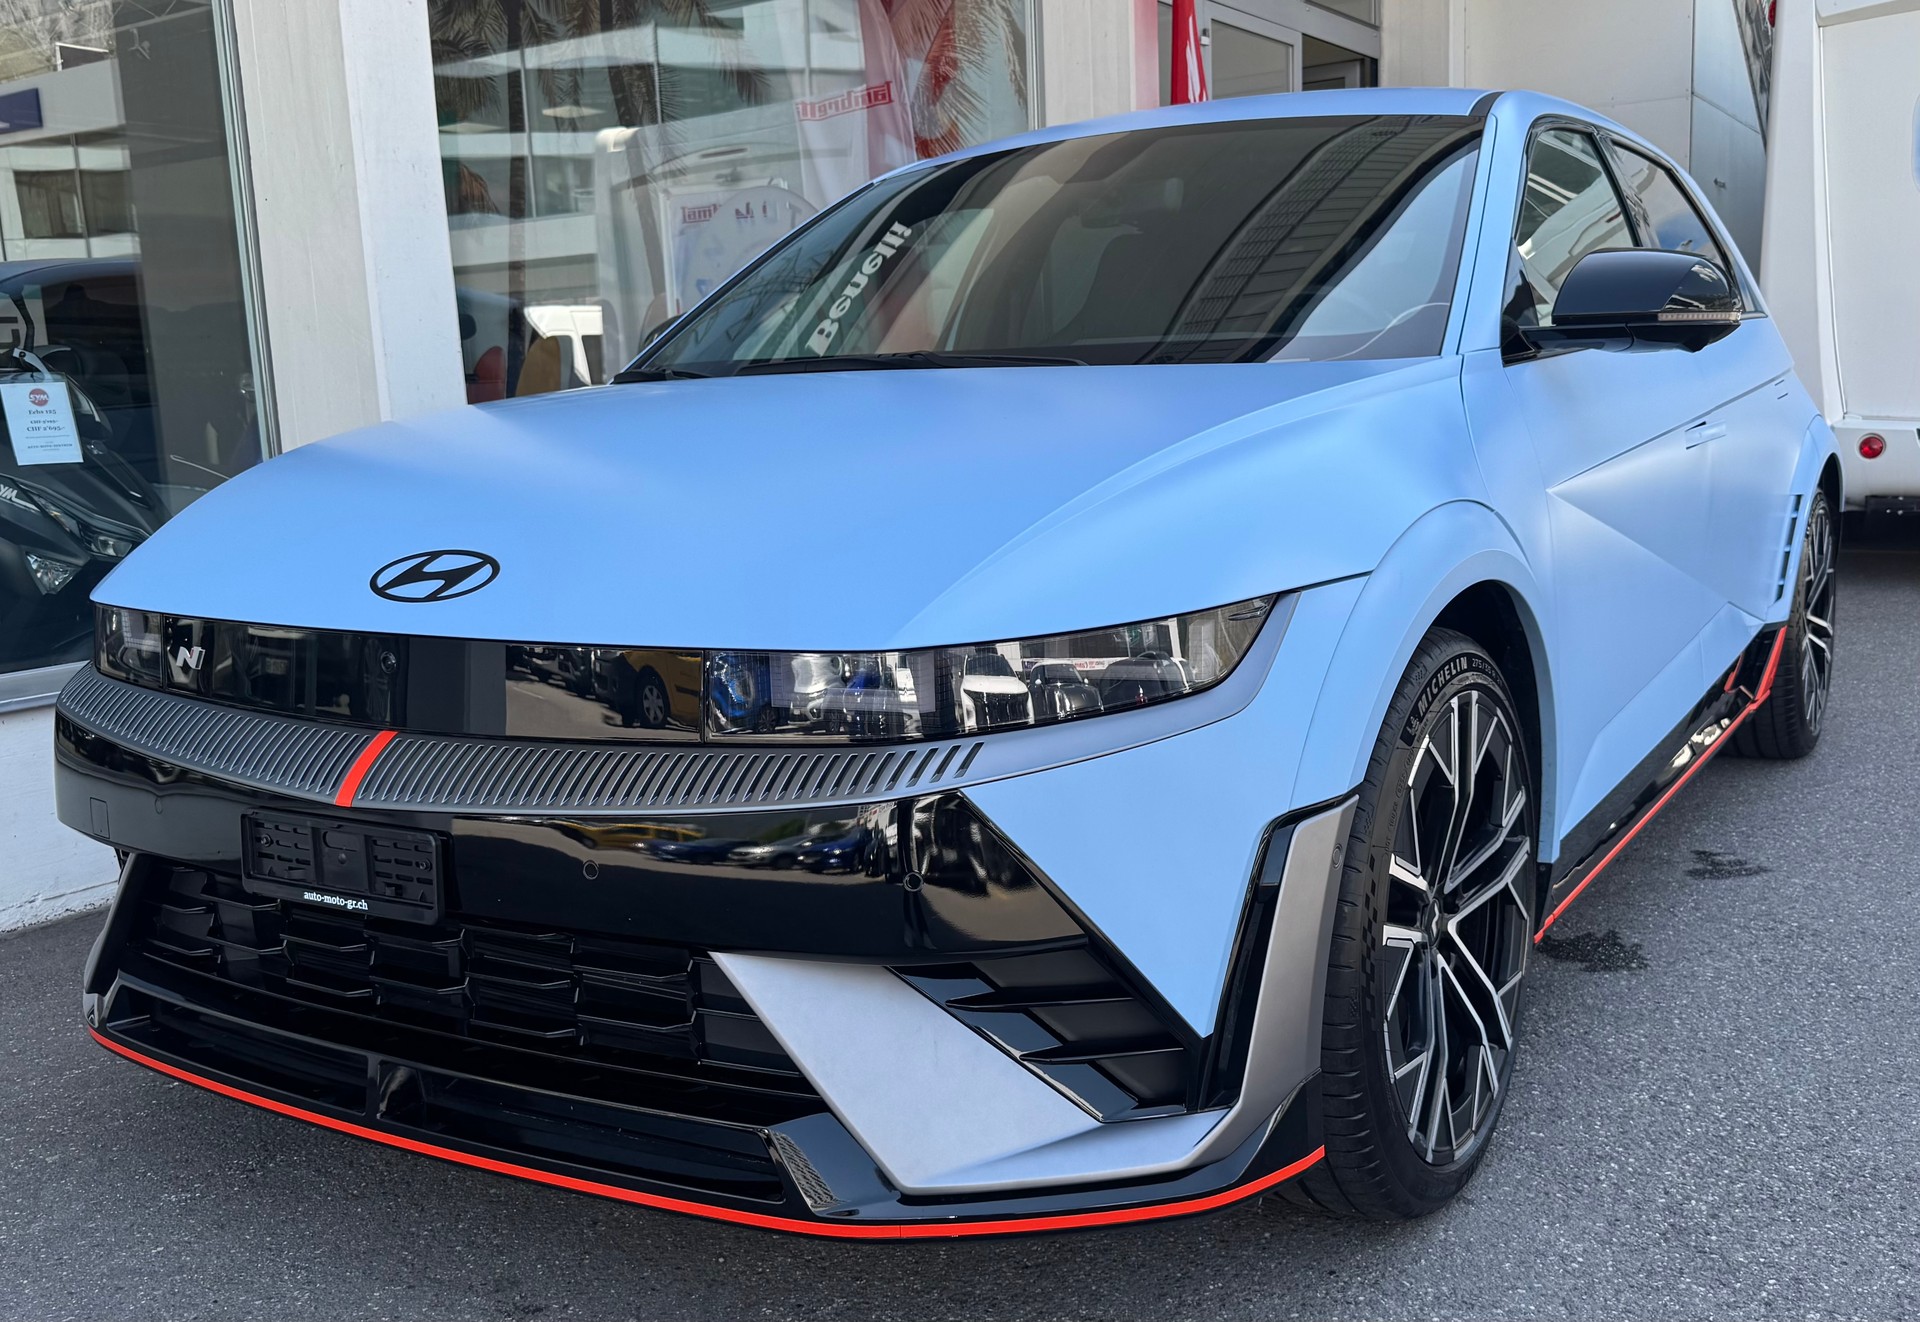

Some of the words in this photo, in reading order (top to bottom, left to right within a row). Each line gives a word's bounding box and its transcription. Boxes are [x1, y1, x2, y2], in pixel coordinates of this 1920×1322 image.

[29, 394, 49, 403] SYM
[1417, 656, 1468, 717] MICHELIN
[303, 891, 368, 910] auto-moto-gr.ch
